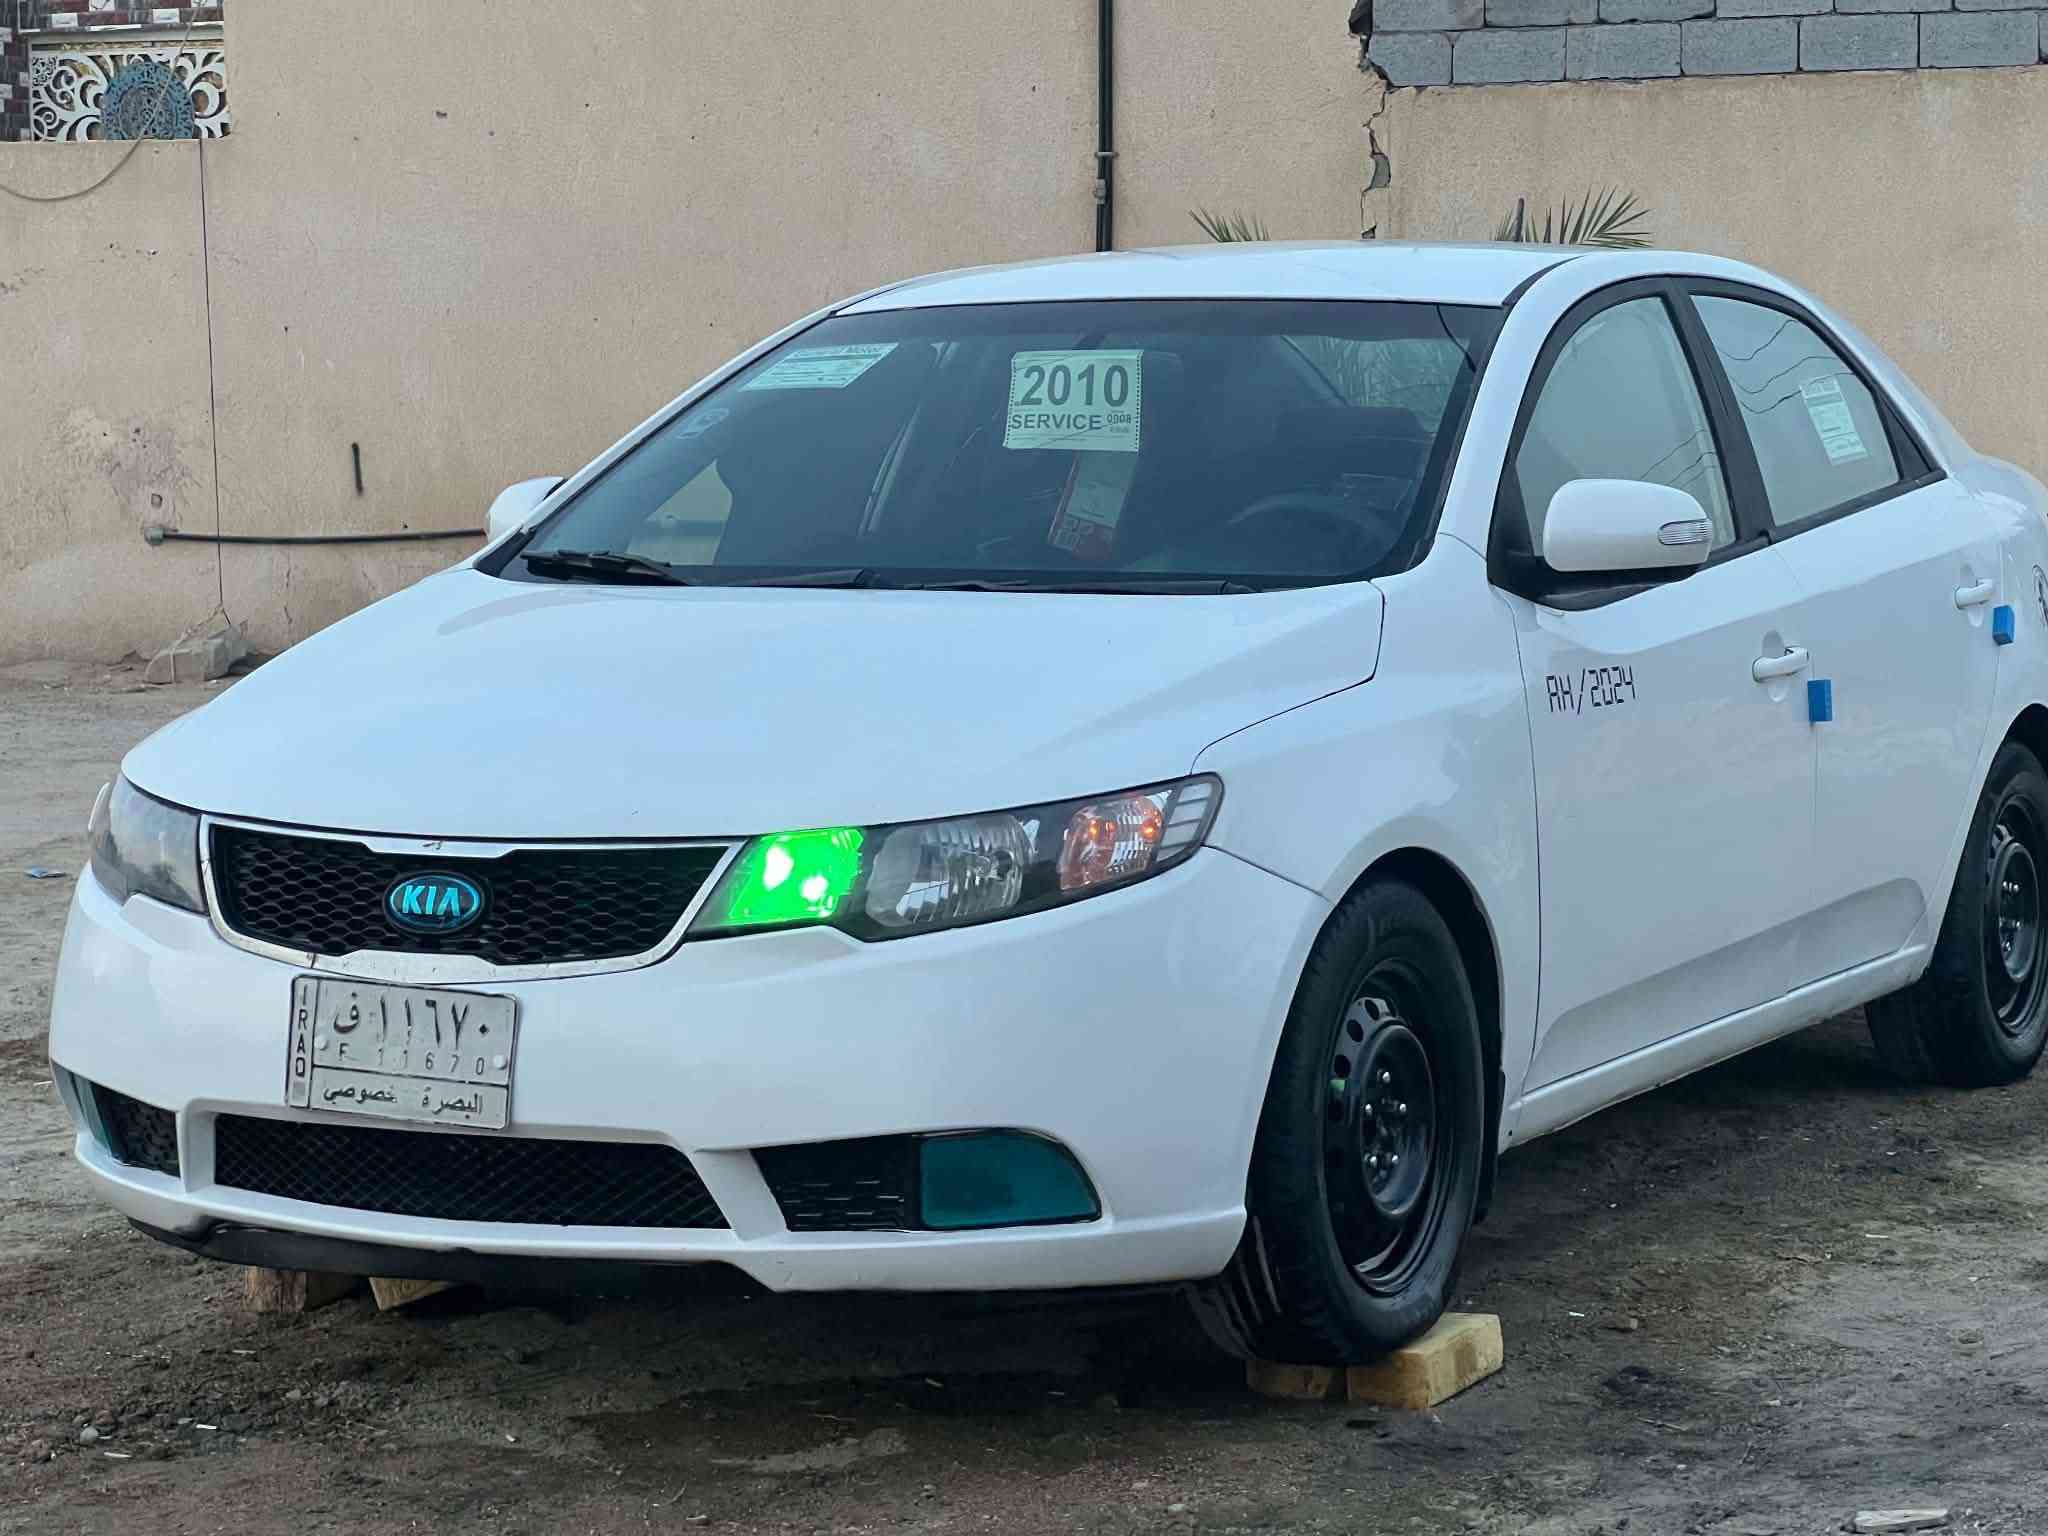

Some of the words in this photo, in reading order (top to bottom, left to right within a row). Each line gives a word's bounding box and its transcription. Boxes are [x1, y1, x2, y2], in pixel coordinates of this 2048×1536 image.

[1020, 363, 1129, 407] 2010
[1011, 413, 1103, 431] SERVICE
[1545, 665, 1636, 715] AH/2024
[401, 885, 461, 917] KIA
[295, 985, 309, 1078] IRAQ
[323, 1084, 398, 1105] خصوصي
[421, 1085, 484, 1120] البصرة
